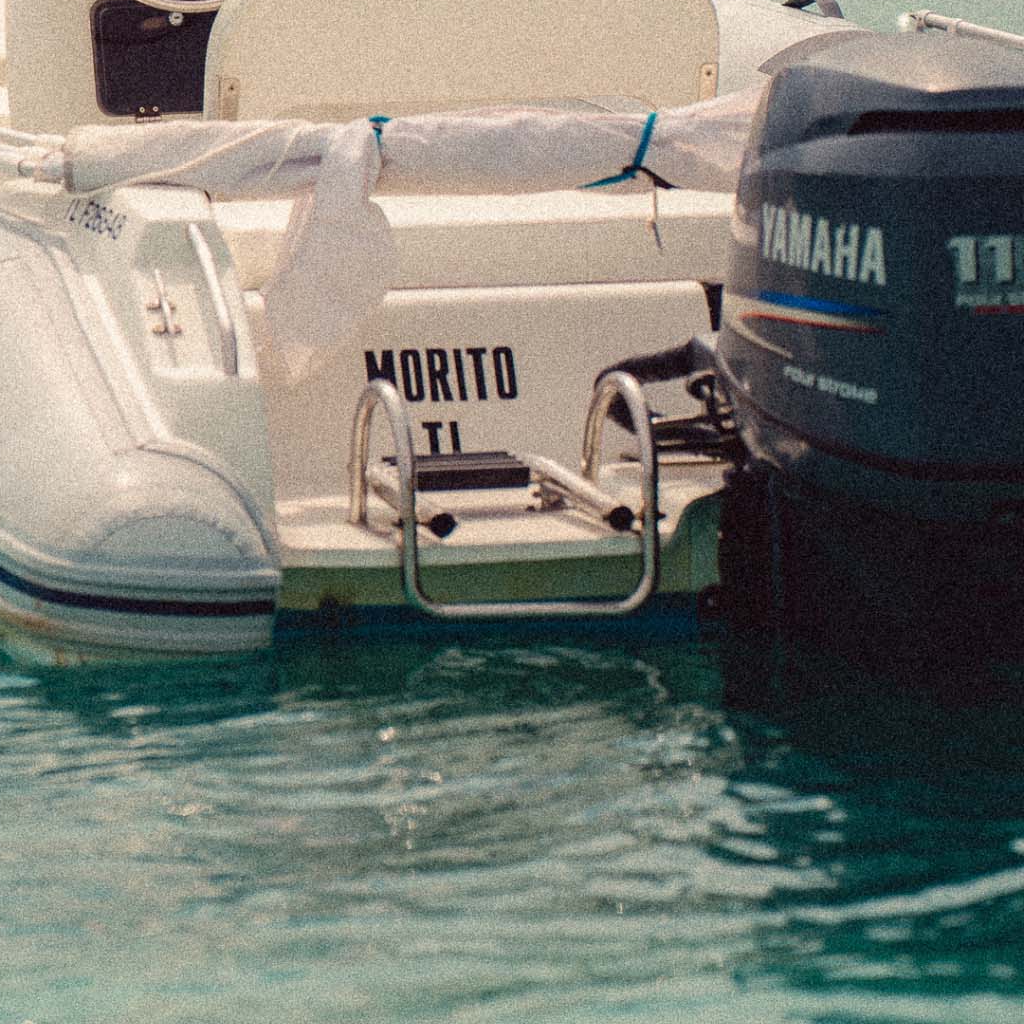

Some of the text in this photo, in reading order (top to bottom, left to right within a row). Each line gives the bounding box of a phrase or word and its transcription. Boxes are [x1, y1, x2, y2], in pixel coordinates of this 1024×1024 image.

[762, 202, 886, 286] YAMAHA
[946, 236, 1024, 282] 11
[364, 347, 518, 402] MORITO
